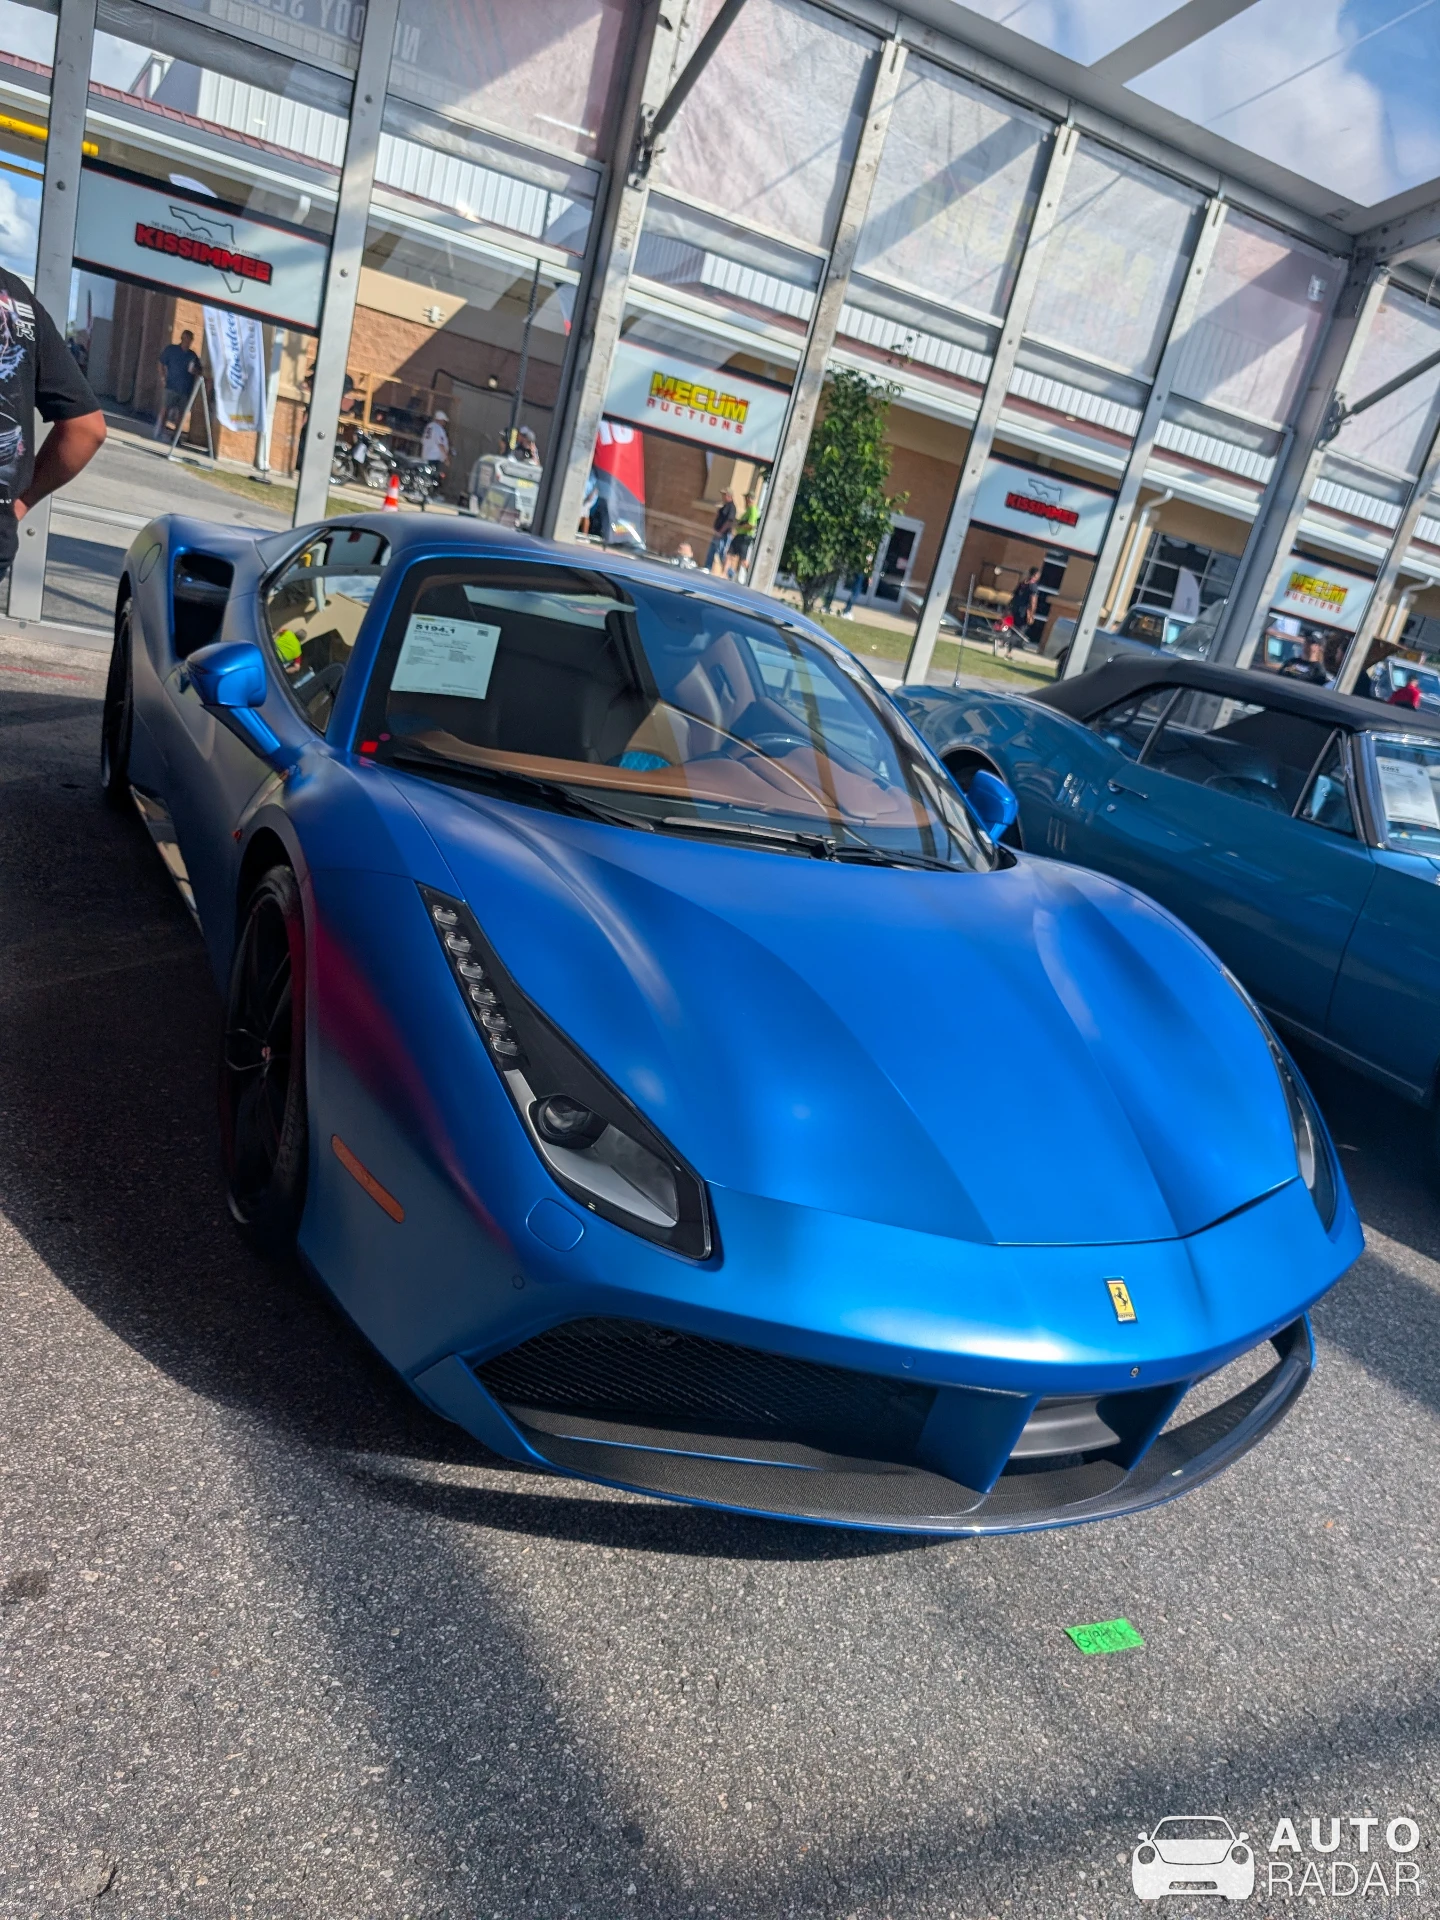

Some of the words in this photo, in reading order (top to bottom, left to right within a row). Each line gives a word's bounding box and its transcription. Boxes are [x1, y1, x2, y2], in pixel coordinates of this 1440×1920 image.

[135, 222, 273, 285] KISSIMMEE
[646, 396, 744, 435] AUCTIONS
[650, 371, 750, 424] MECUM
[1005, 492, 1079, 527] KISSIMMEE
[1284, 589, 1342, 614] AUCTIONS
[1288, 571, 1348, 605] MECUM
